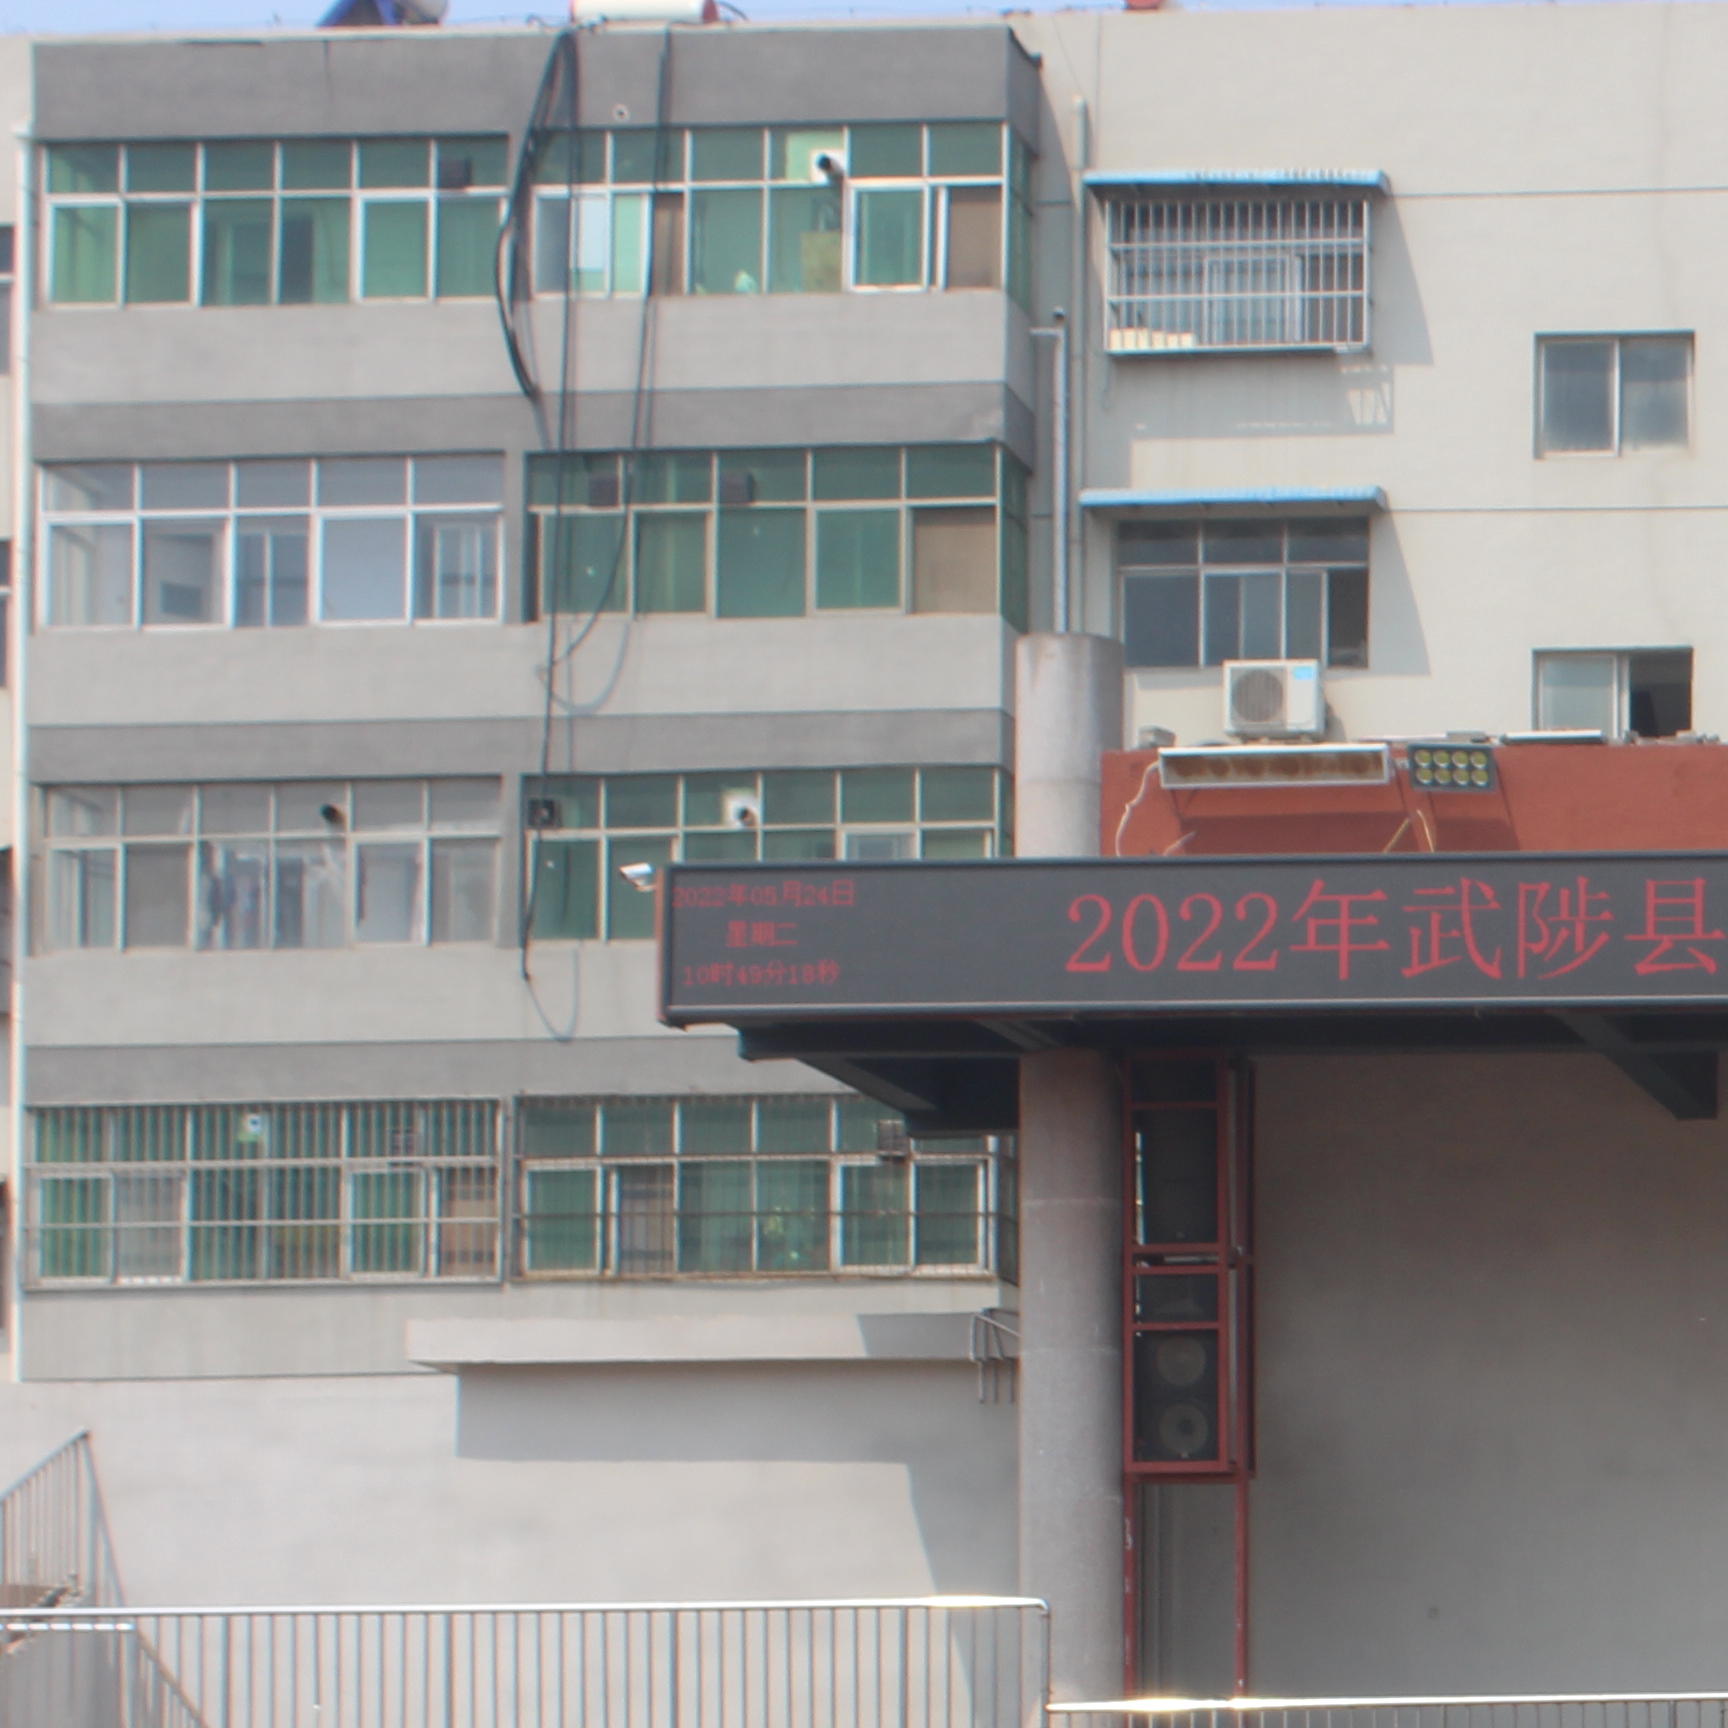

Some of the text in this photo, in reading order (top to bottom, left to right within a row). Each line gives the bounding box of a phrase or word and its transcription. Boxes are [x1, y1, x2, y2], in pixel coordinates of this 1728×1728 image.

[672, 879, 855, 908] 2022年05月24日
[727, 920, 797, 948] 星期二
